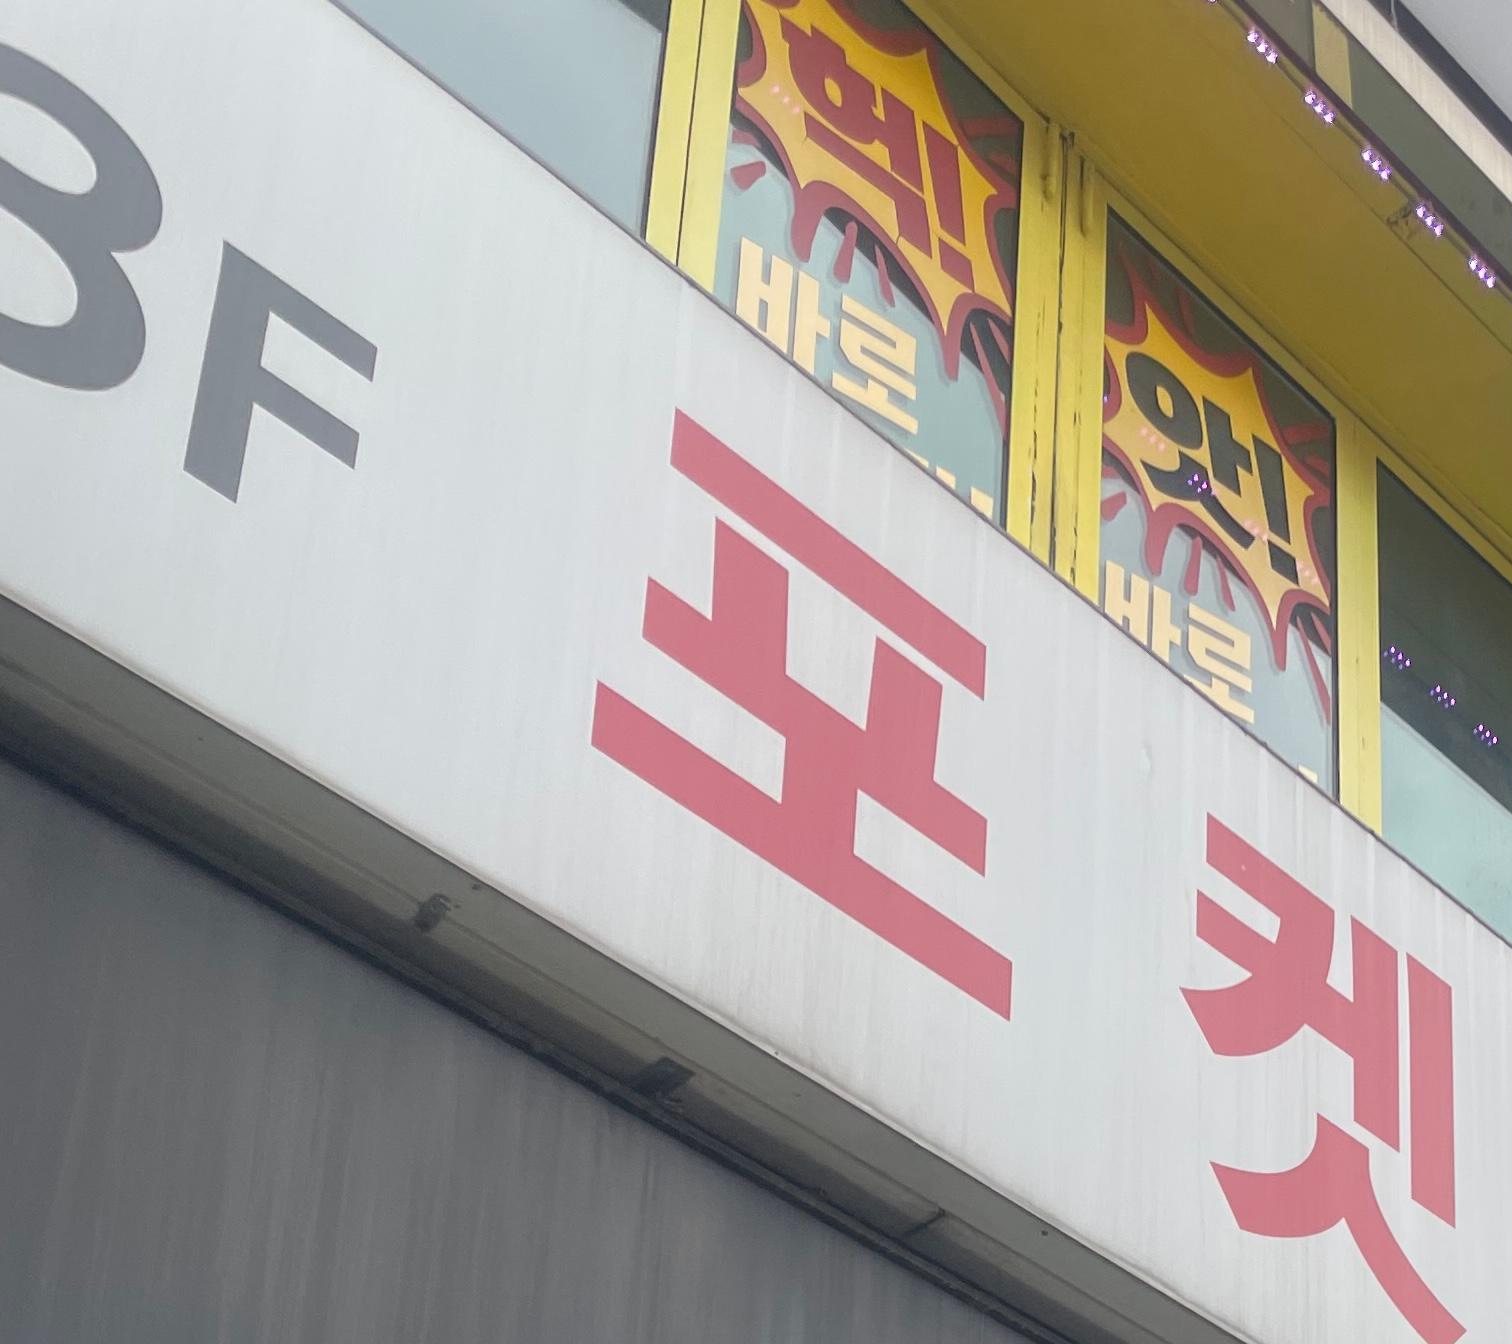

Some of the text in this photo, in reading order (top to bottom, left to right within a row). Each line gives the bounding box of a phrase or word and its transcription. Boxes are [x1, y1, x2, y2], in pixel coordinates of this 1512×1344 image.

[736, 237, 919, 435] 바로
[1125, 351, 1300, 587] 앗!
[1104, 560, 1255, 724] 바로
